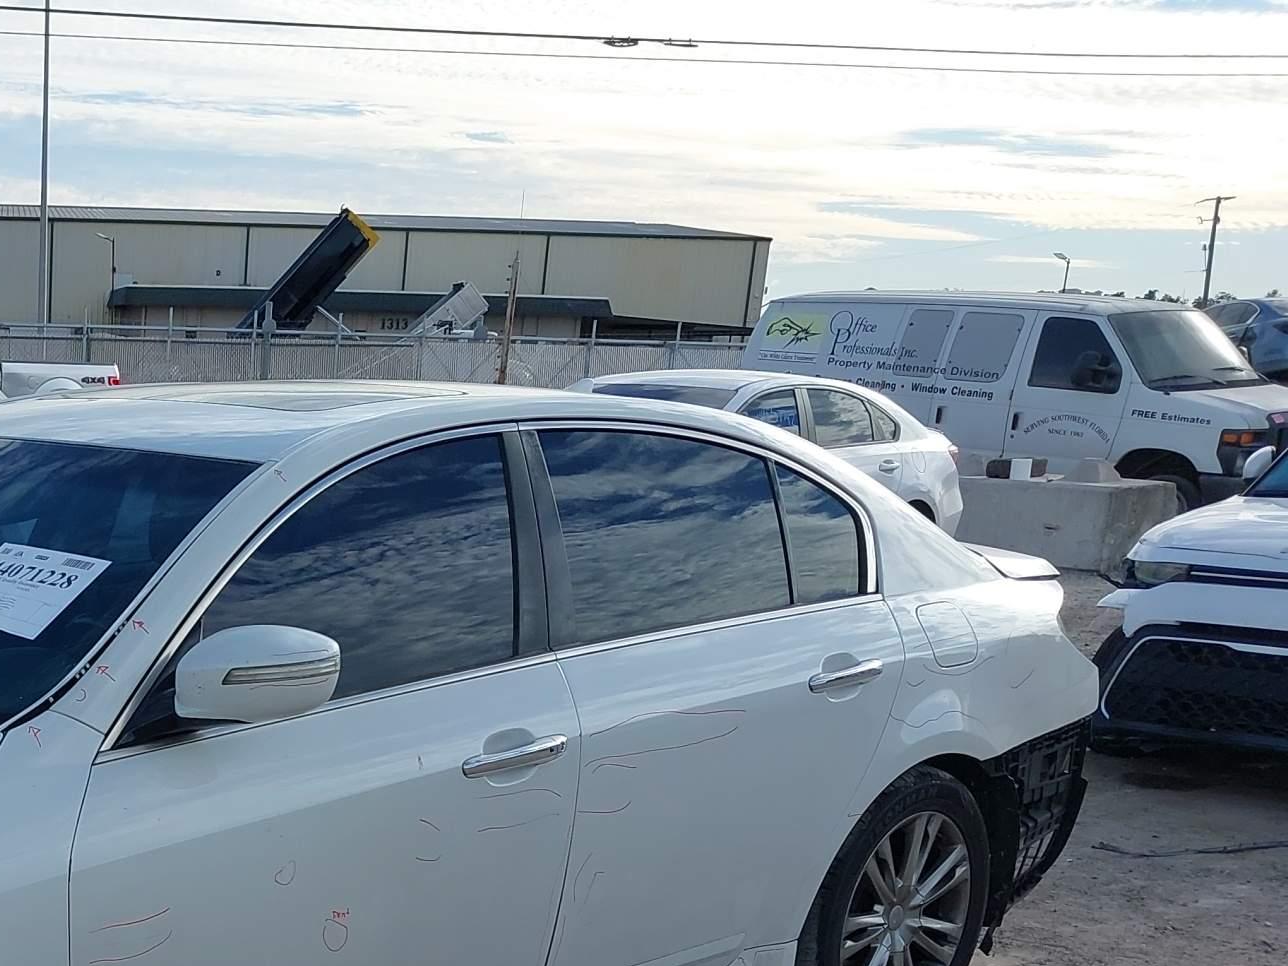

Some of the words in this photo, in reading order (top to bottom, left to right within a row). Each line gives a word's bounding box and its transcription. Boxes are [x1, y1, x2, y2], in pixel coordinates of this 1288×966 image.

[380, 318, 409, 330] 1313
[830, 311, 878, 337] Office
[830, 328, 897, 358] Professionals
[827, 357, 873, 372] Property
[876, 361, 947, 375] Maintenance
[950, 366, 1000, 380] Division
[912, 383, 948, 395] Window
[951, 386, 994, 400] Cleaning
[1131, 409, 1157, 419] FREE
[1161, 412, 1212, 425] Estimates
